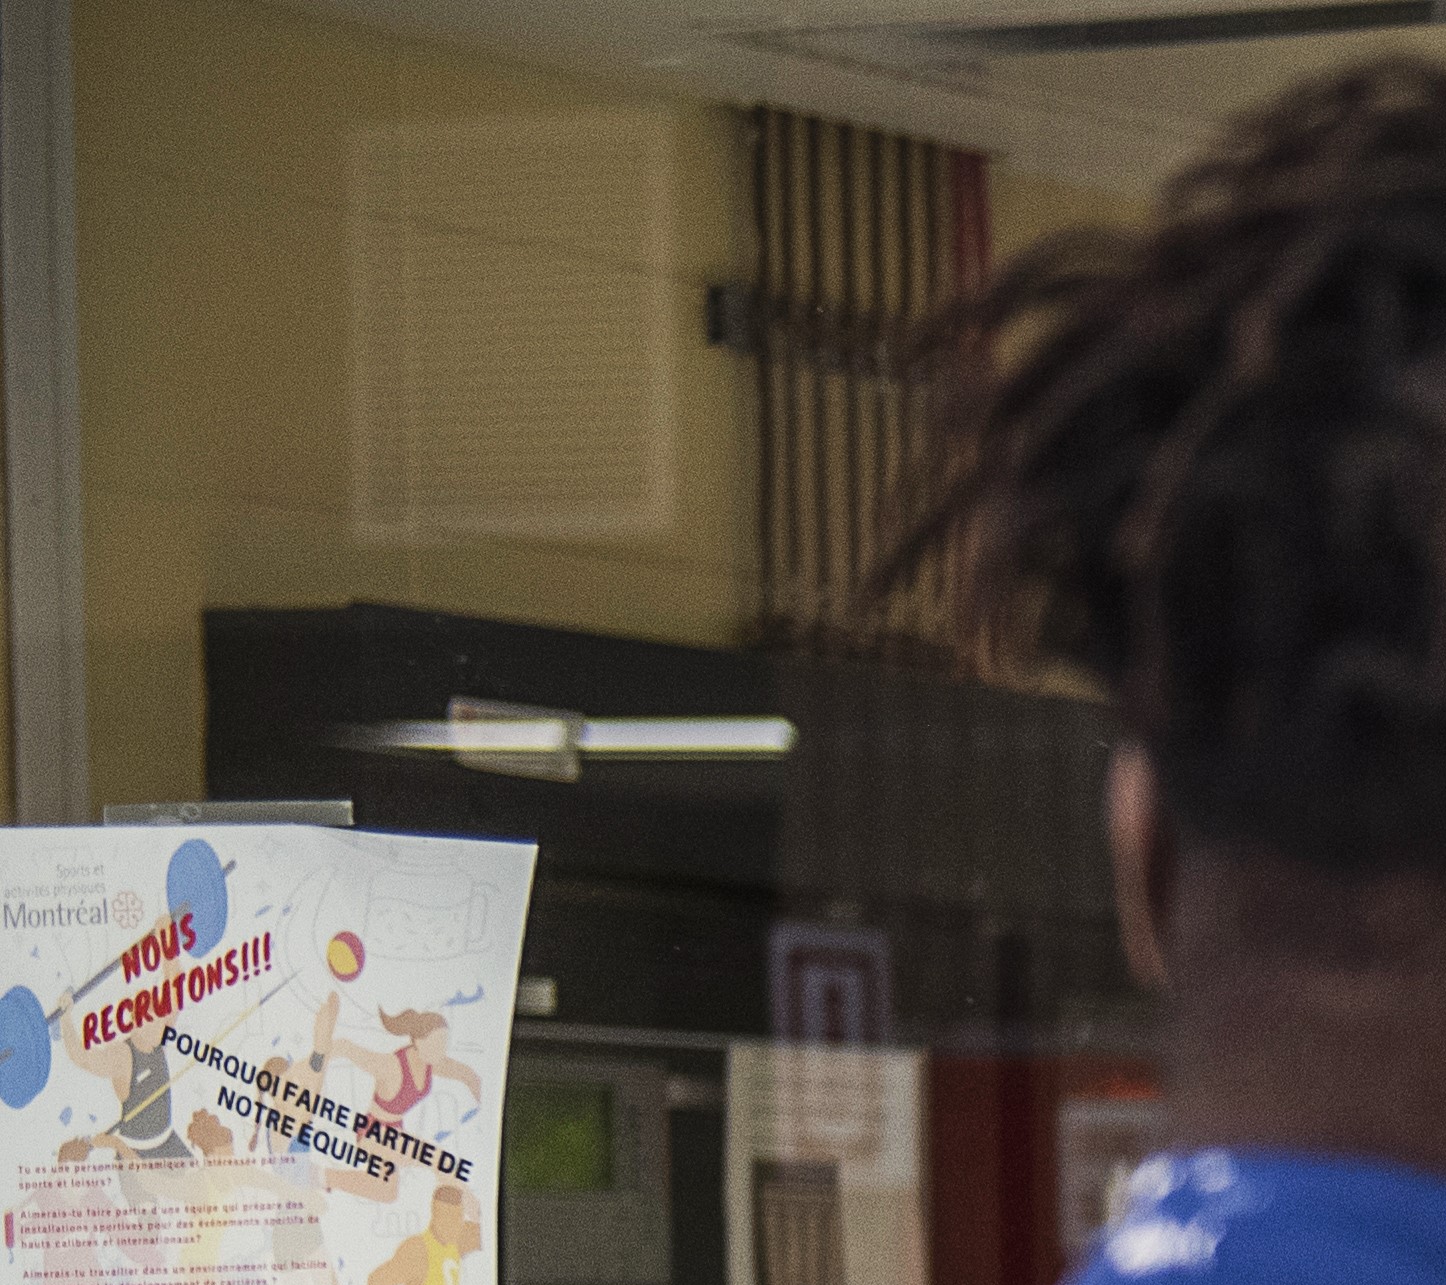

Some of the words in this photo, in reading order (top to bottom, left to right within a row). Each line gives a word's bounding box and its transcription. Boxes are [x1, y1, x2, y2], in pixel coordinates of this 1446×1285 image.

[3, 897, 108, 928] Montréal
[120, 913, 196, 984] NOUS
[82, 932, 272, 1050] RECRUTONS!!!
[161, 1025, 280, 1097] POURQUOI
[283, 1081, 348, 1128] FAIRE
[353, 1113, 435, 1166] PARTIE
[438, 1152, 474, 1182] DE
[217, 1085, 293, 1138] NOTRE
[298, 1119, 396, 1183] ÉQUIPE?
[18, 1165, 31, 1175] Tu
[35, 1165, 47, 1174] es
[51, 1164, 70, 1174] une
[74, 1162, 124, 1174] personne
[128, 1159, 185, 1172] dynamique
[57, 1179, 67, 1188] et
[20, 1207, 82, 1219] Aimerais-tu
[87, 1207, 111, 1218] faire
[115, 1207, 147, 1219] partie
[20, 1224, 89, 1235] installations
[93, 1222, 143, 1234] sportives
[176, 1219, 194, 1229] des
[21, 1238, 51, 1249] hauts
[103, 1236, 113, 1247] et
[143, 1265, 168, 1276] dans
[172, 1266, 186, 1275] un
